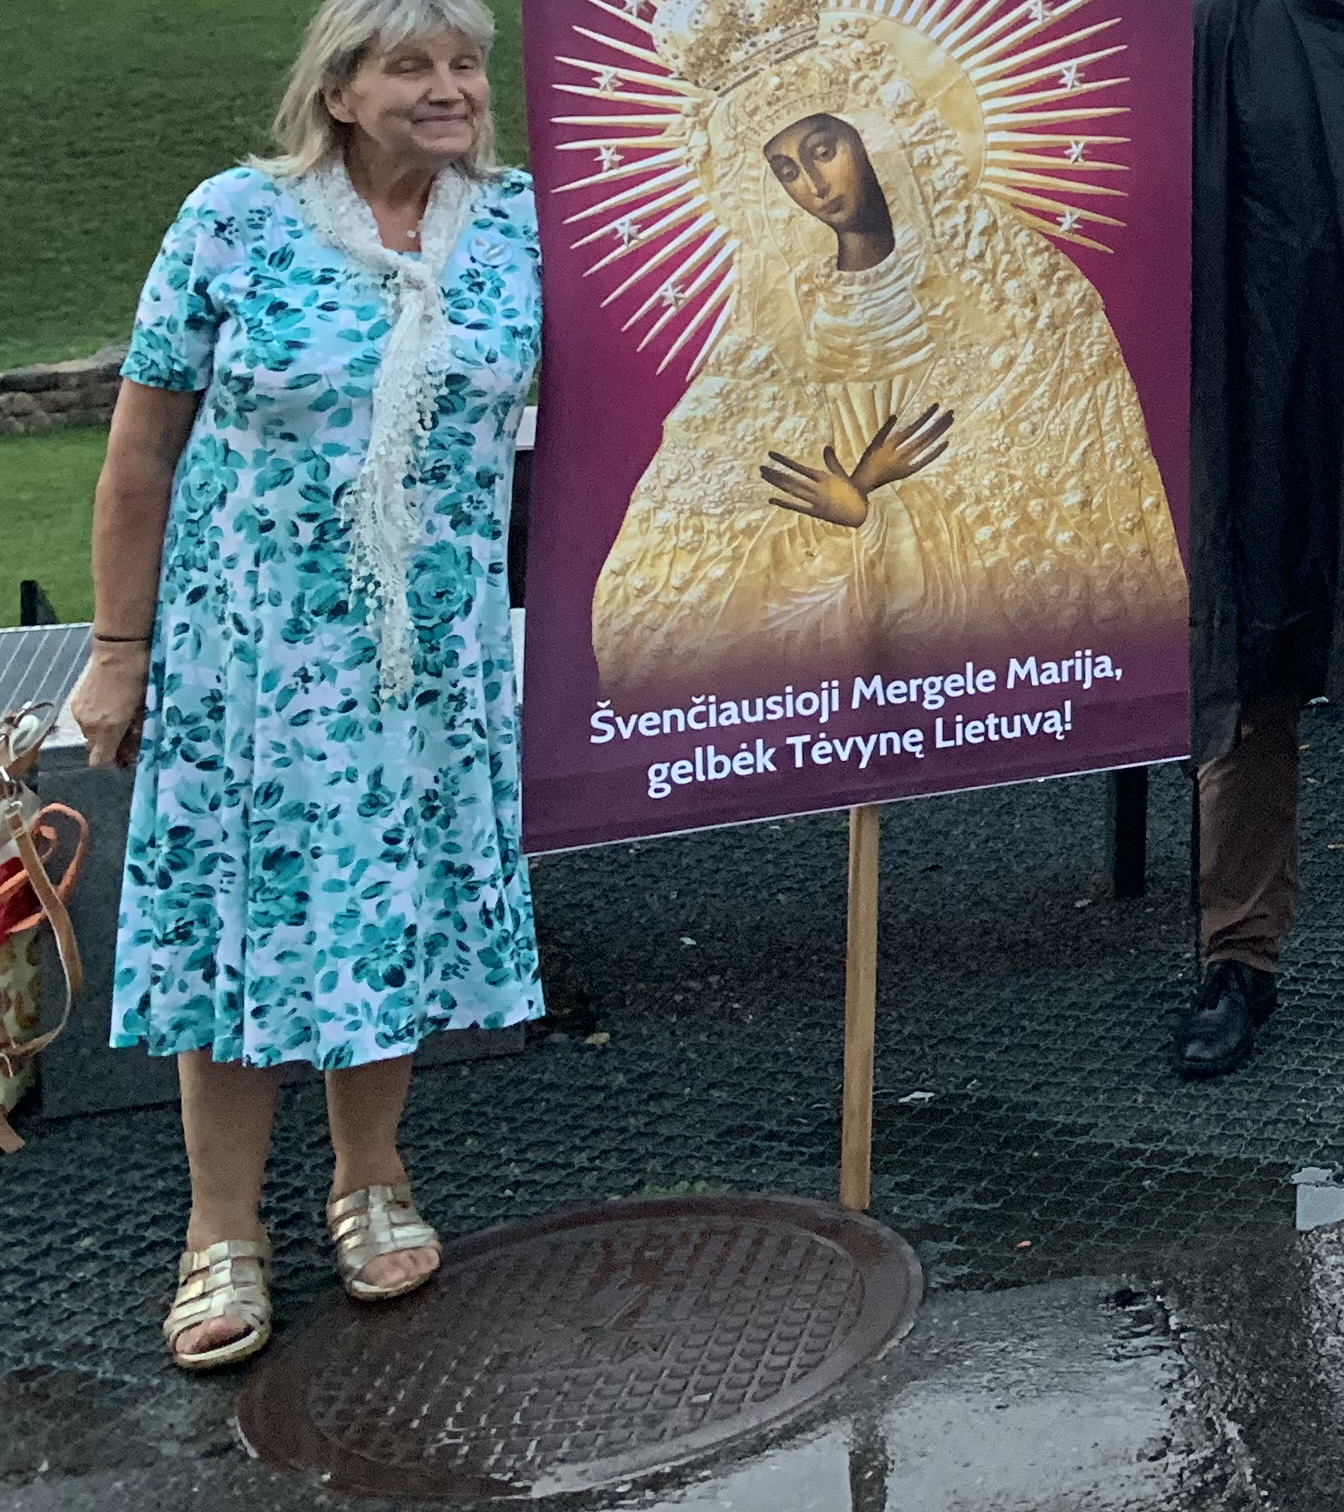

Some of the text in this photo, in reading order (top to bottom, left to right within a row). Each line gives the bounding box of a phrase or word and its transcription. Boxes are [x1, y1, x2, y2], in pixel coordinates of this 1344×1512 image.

[590, 649, 1123, 744] Švenčiausioji Mergele Marija,
[647, 699, 1073, 799] gelbėk Tėvynę Lietuvą!
